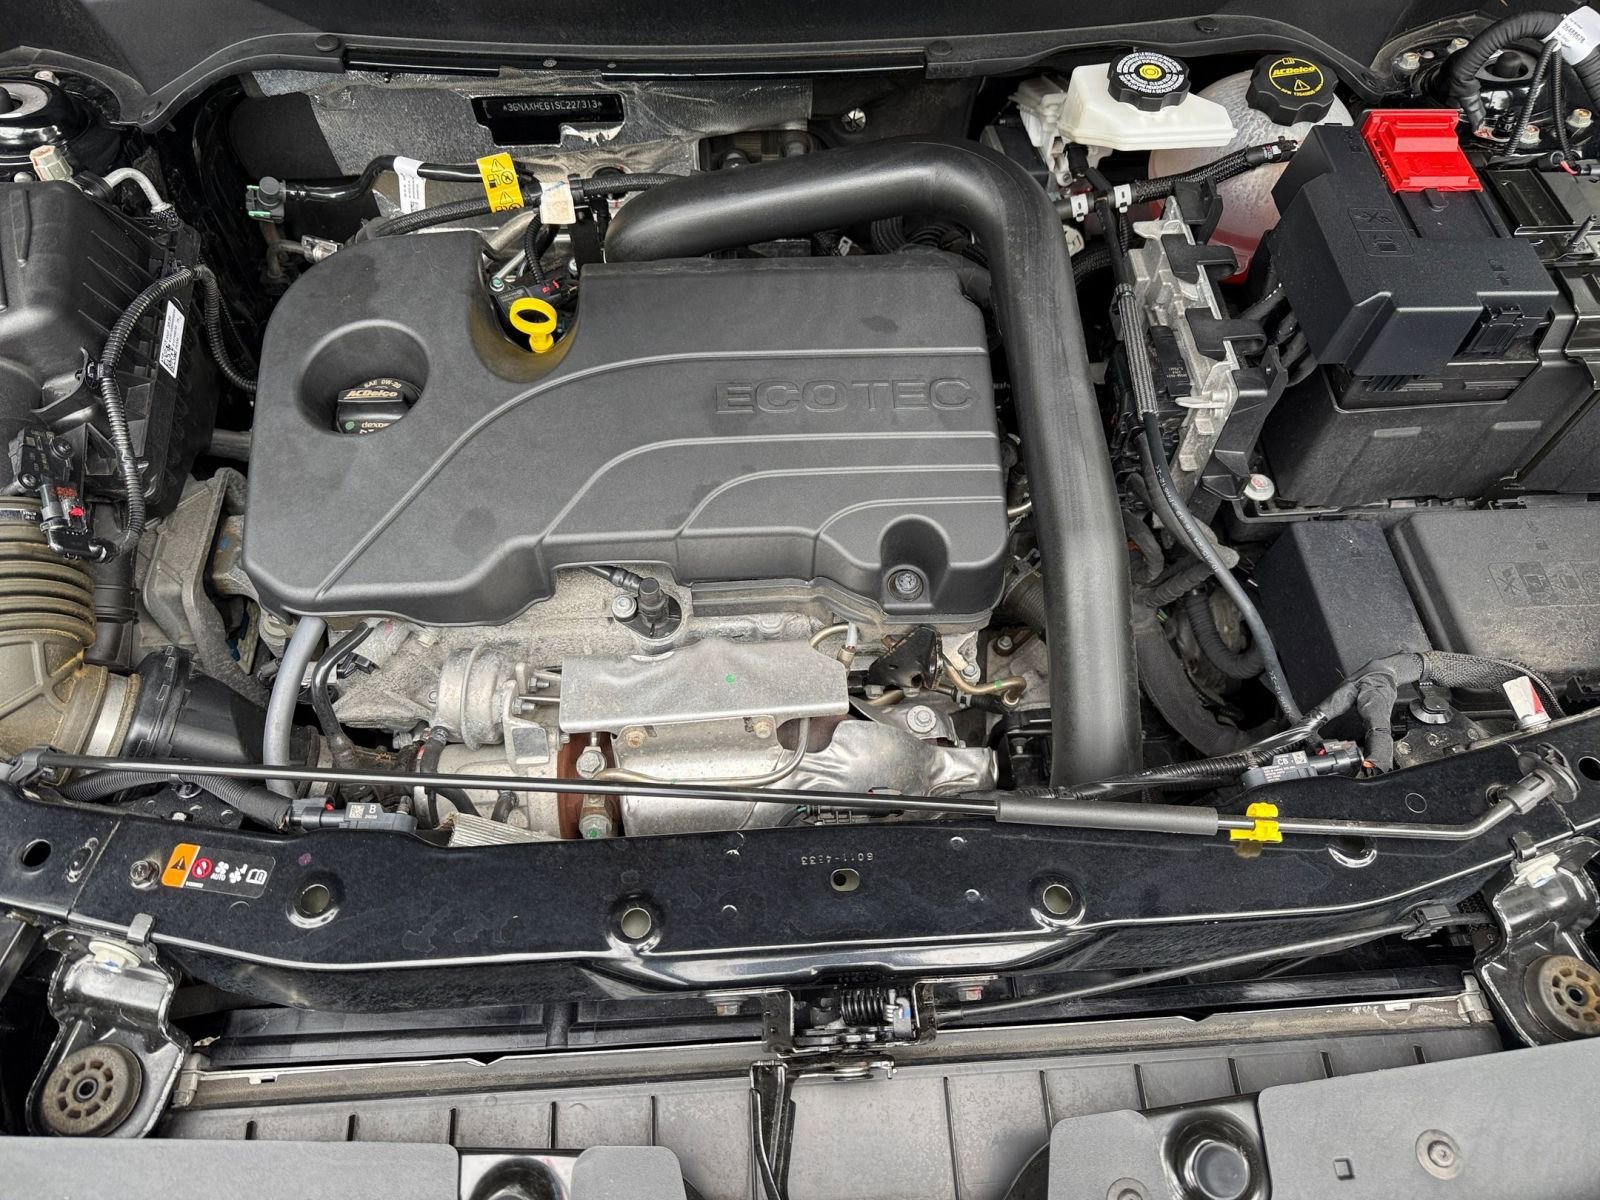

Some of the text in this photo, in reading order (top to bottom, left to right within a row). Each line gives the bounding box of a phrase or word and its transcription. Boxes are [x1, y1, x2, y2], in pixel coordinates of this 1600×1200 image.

[1272, 66, 1316, 77] ACDelco
[364, 380, 377, 388] SAE
[346, 389, 398, 398] ACDelco
[716, 377, 971, 414] ECOTEC
[368, 804, 378, 814] B
[210, 872, 226, 881] AUTO
